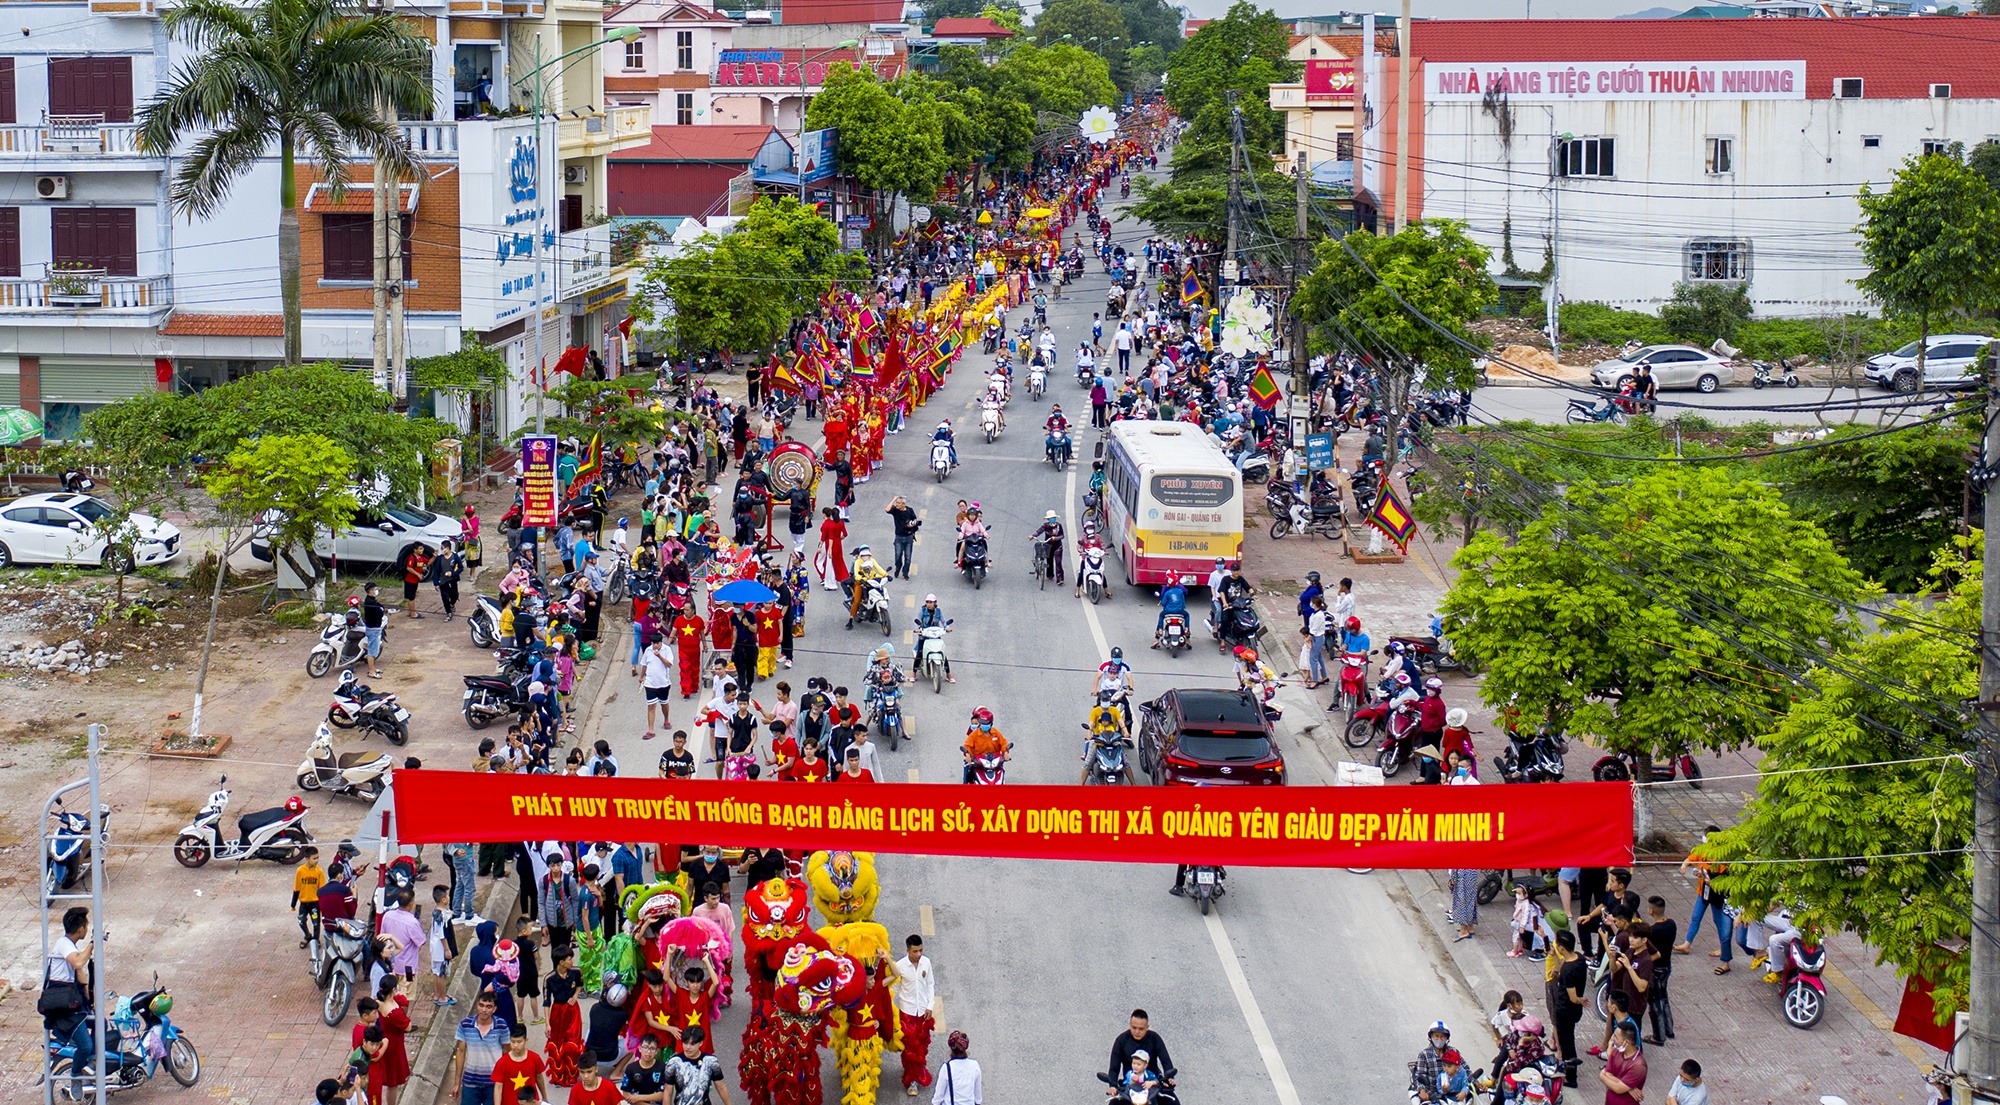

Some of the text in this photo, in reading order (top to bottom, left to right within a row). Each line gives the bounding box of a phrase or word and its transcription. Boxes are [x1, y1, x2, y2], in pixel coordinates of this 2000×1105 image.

[1439, 63, 1793, 98] NHÀ HÀNG TIỆC CƯỚI THUẬN NHUNG
[1160, 478, 1223, 490] PHÚC XUYÊN
[511, 792, 563, 816] PHÁT
[569, 797, 607, 818] HUY
[613, 795, 691, 821] TRUYỀN
[695, 796, 763, 825] THỐNG
[768, 803, 823, 831] BẠCH
[828, 799, 883, 831] ĐẰNG
[890, 808, 935, 836] LỊCH
[942, 802, 974, 832] SỬ,
[981, 804, 1021, 833] XÂY
[1026, 807, 1082, 839] DỰNG
[1088, 809, 1120, 840] THỊ
[1125, 806, 1154, 835] XÃ
[1162, 803, 1232, 838] QUẢNG
[1239, 807, 1279, 839] YÊN
[1285, 807, 1334, 841] GIÀU
[1434, 812, 1491, 842] MINH
[1497, 812, 1505, 841] !
